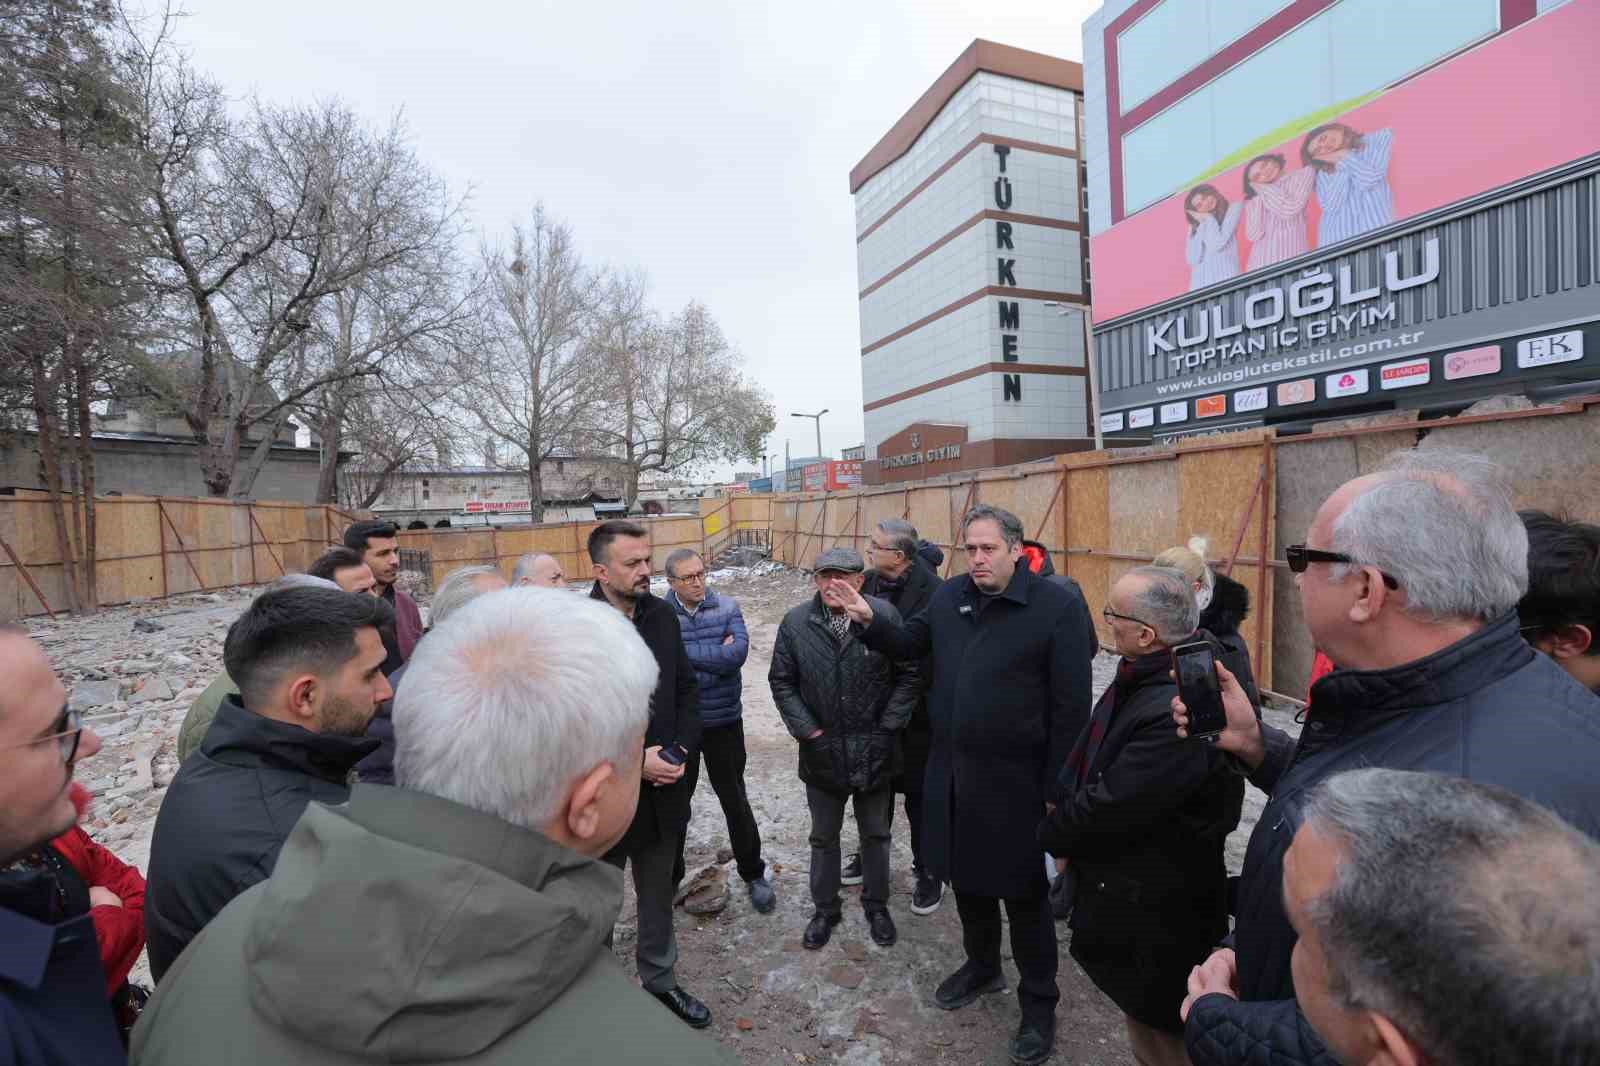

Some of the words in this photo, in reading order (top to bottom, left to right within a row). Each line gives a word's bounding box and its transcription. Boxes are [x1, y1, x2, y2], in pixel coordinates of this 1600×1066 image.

[993, 144, 1021, 401] TÜRKMEN
[1148, 238, 1439, 355] KULOĞLU
[1156, 331, 1425, 394] www.kuloglutekstil.com.tr
[1172, 334, 1265, 369] TOPTAN
[1273, 326, 1299, 348] İÇ
[1307, 302, 1395, 339] GİYİM
